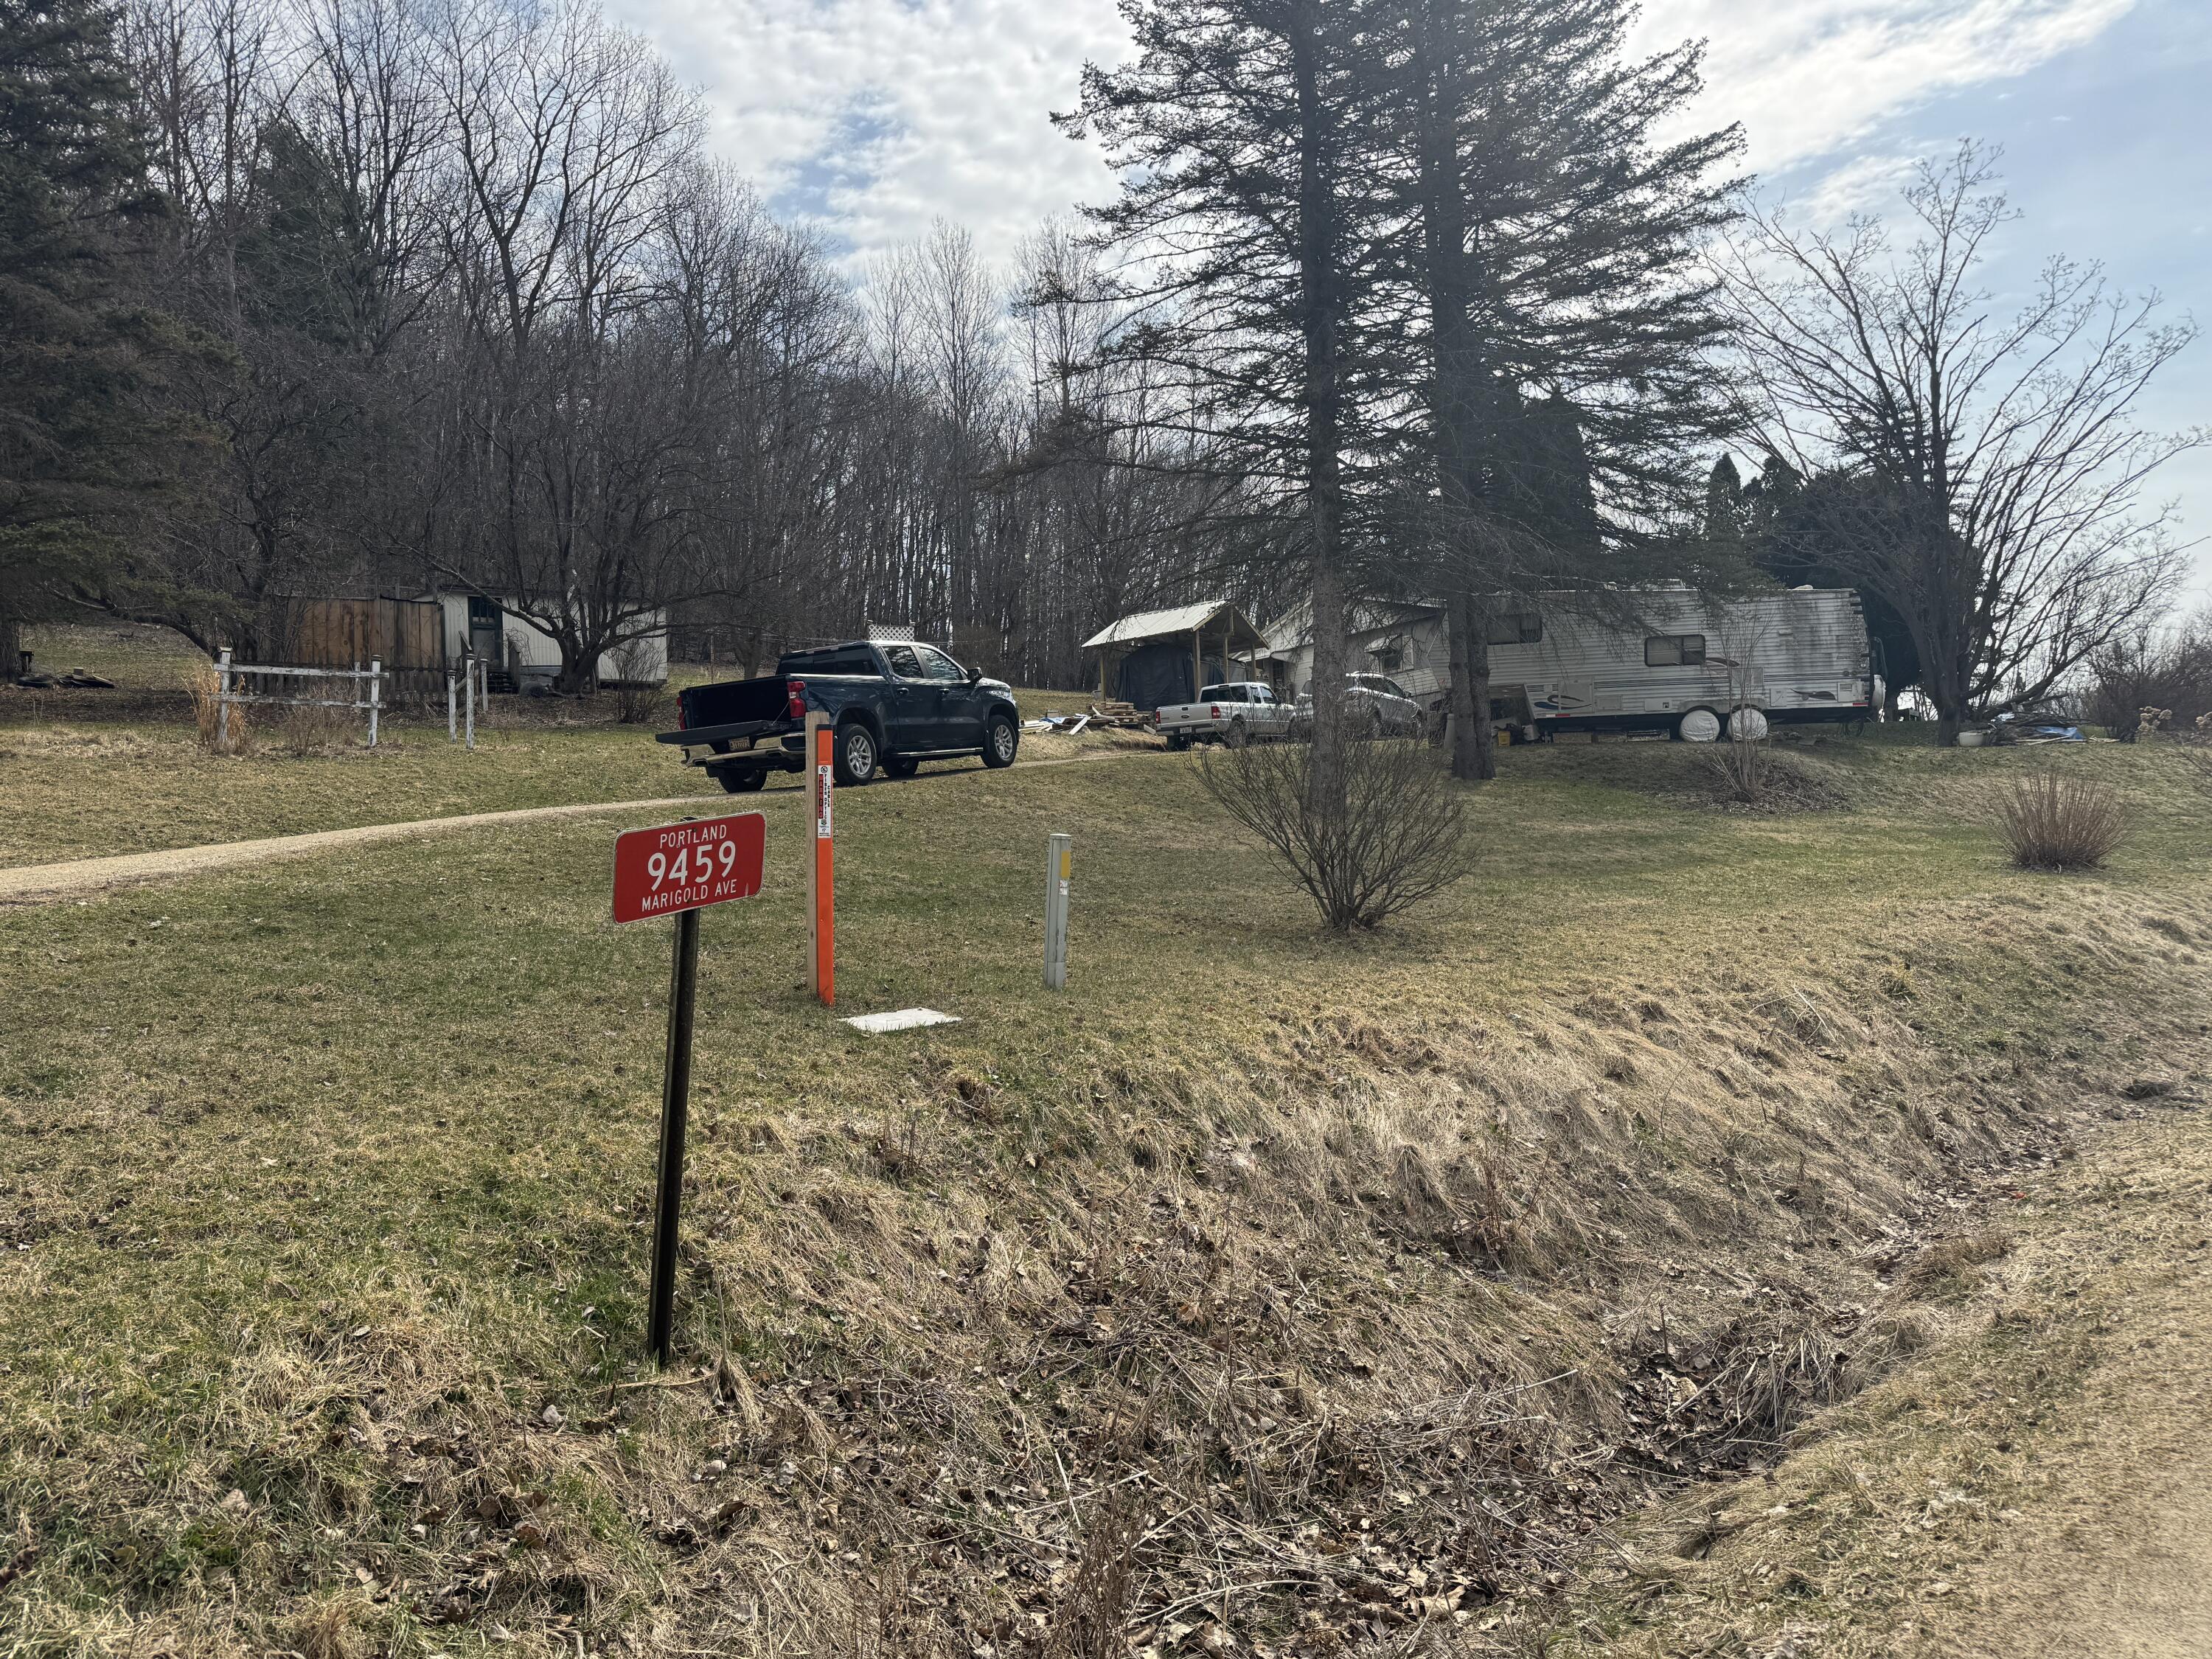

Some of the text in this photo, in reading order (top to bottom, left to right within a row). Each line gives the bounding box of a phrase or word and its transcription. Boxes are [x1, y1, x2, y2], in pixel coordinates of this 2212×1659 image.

[660, 824, 727, 849] PORTLAND
[648, 841, 736, 892] 9459
[641, 879, 737, 912] MARIGOLD AVE
